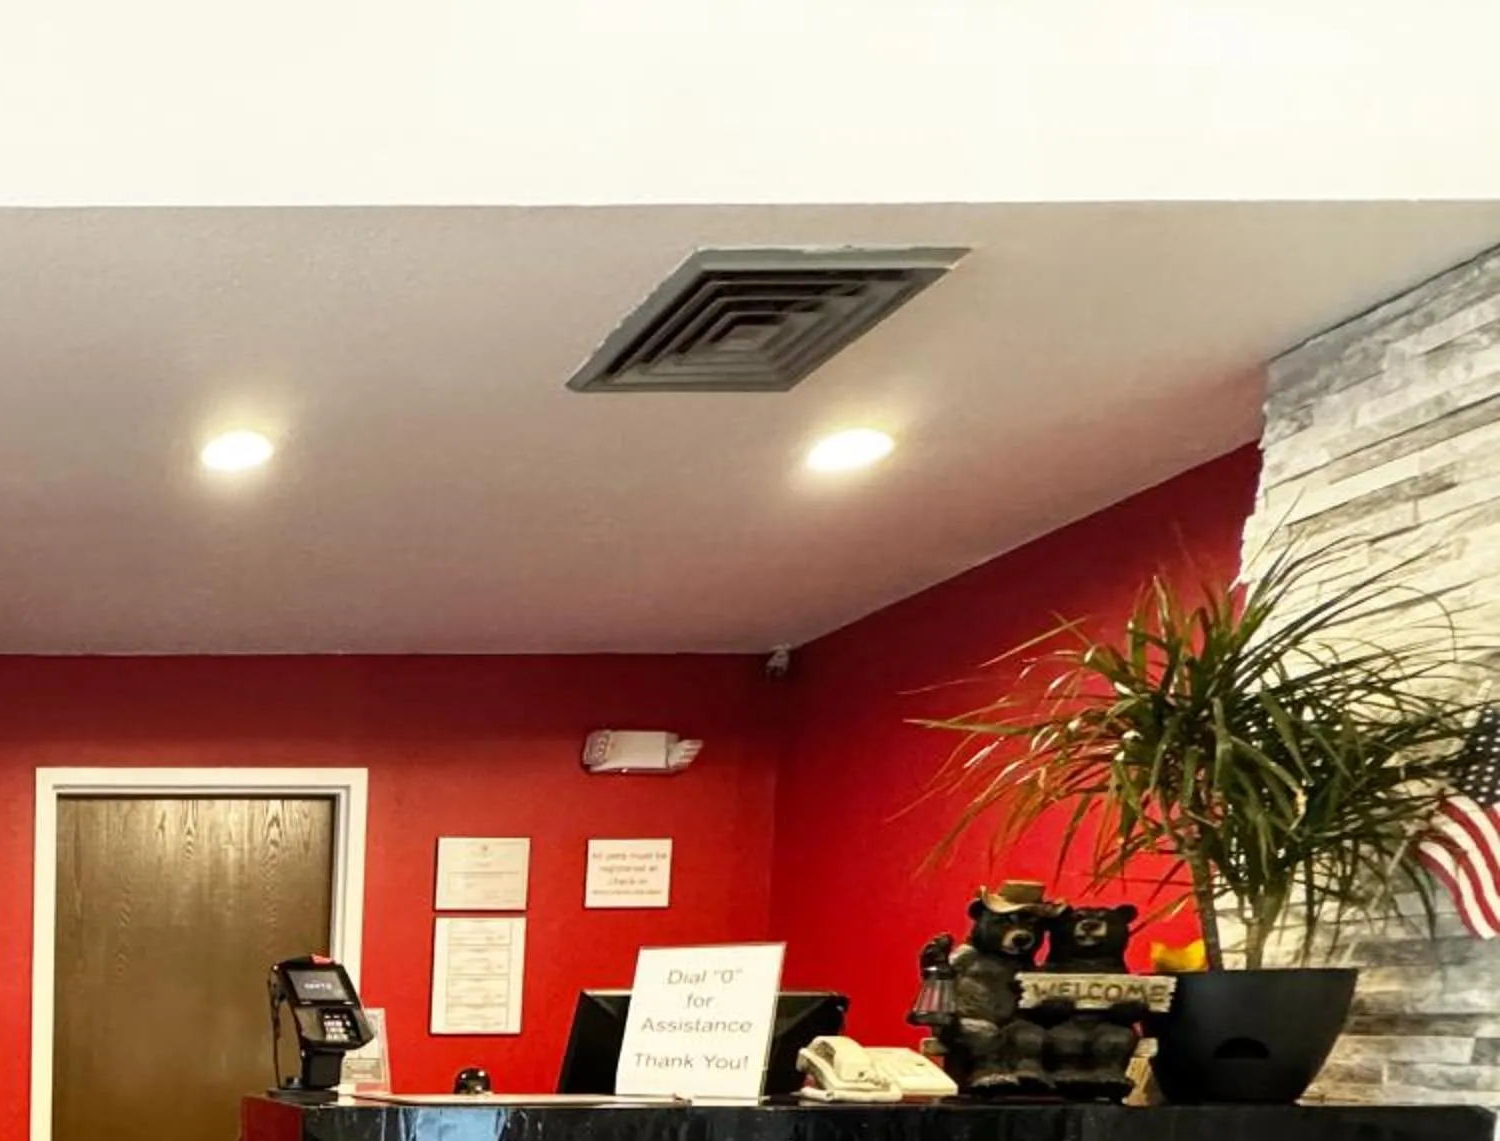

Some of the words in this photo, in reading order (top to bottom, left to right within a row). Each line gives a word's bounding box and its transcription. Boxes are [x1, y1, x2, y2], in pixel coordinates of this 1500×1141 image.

[667, 969, 707, 985] Dial
[1031, 981, 1167, 1003] WELCOME
[686, 994, 715, 1008] for
[641, 1018, 753, 1033] Assistance
[635, 1053, 693, 1069] Thank
[704, 1055, 749, 1070] You!
